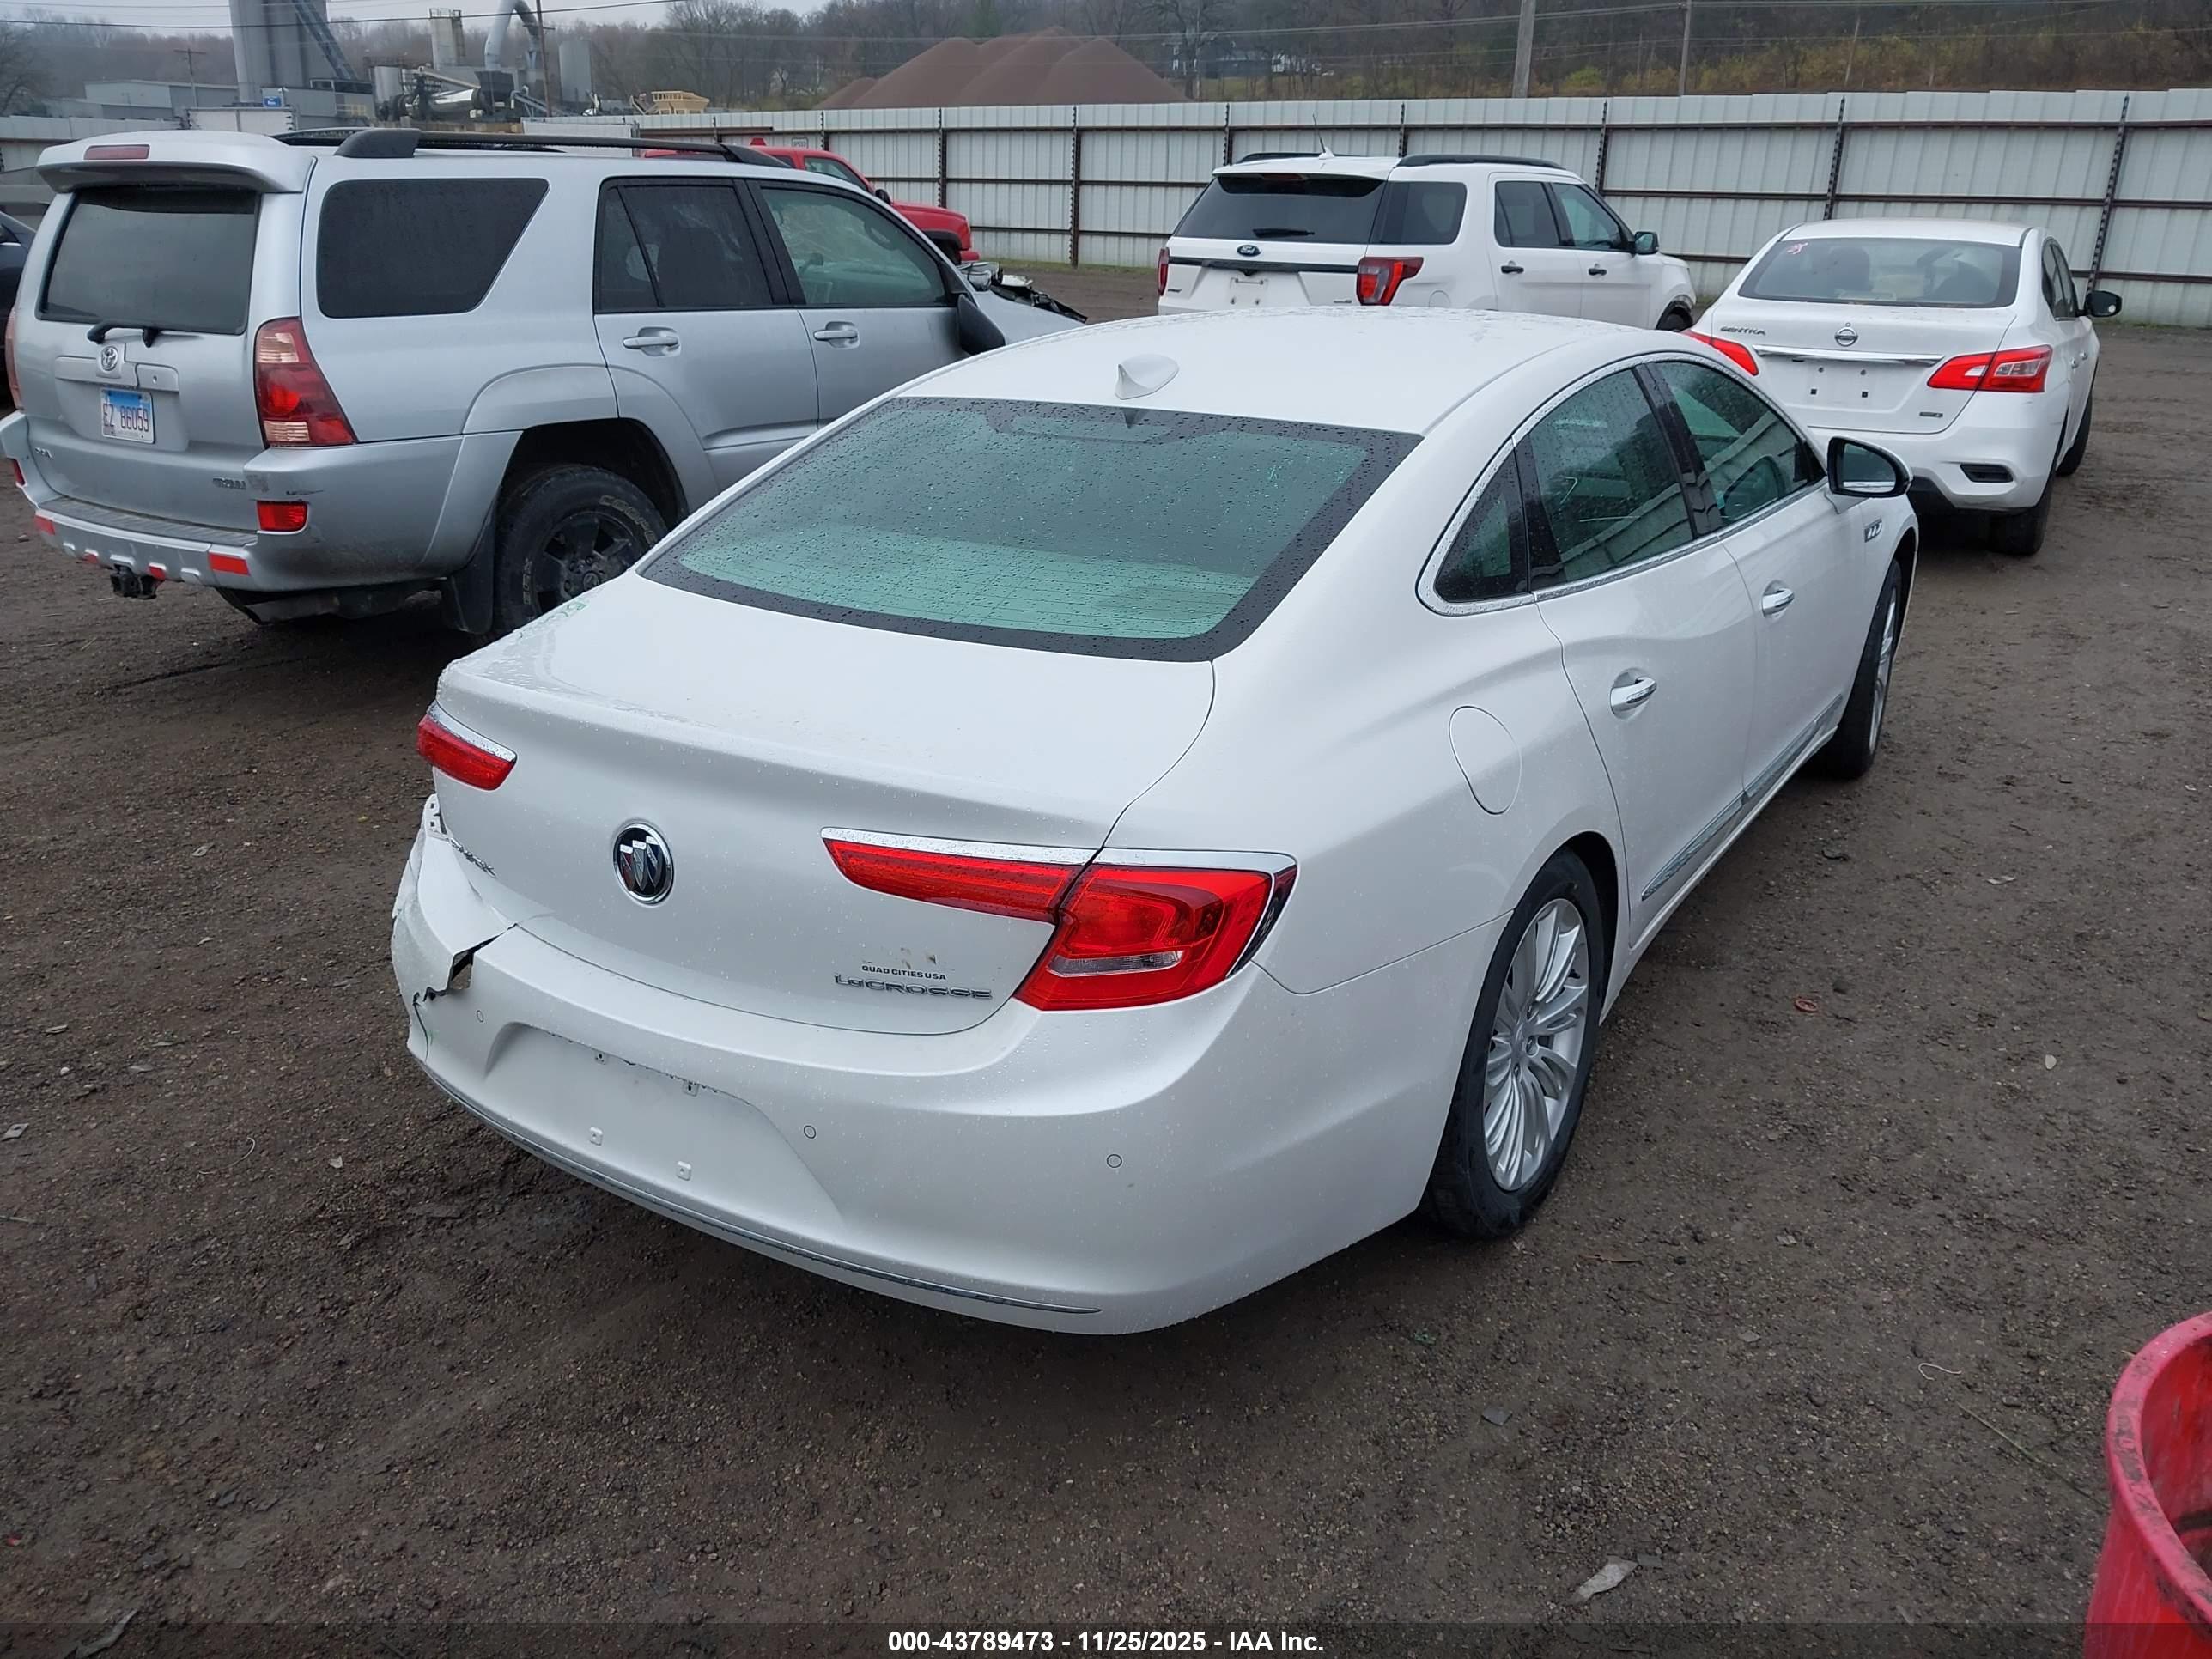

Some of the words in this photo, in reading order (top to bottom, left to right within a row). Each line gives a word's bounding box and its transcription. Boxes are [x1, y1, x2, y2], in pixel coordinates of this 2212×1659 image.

[103, 403, 115, 427] EZ
[862, 965, 890, 975] QUAD
[891, 969, 923, 978] CITIES
